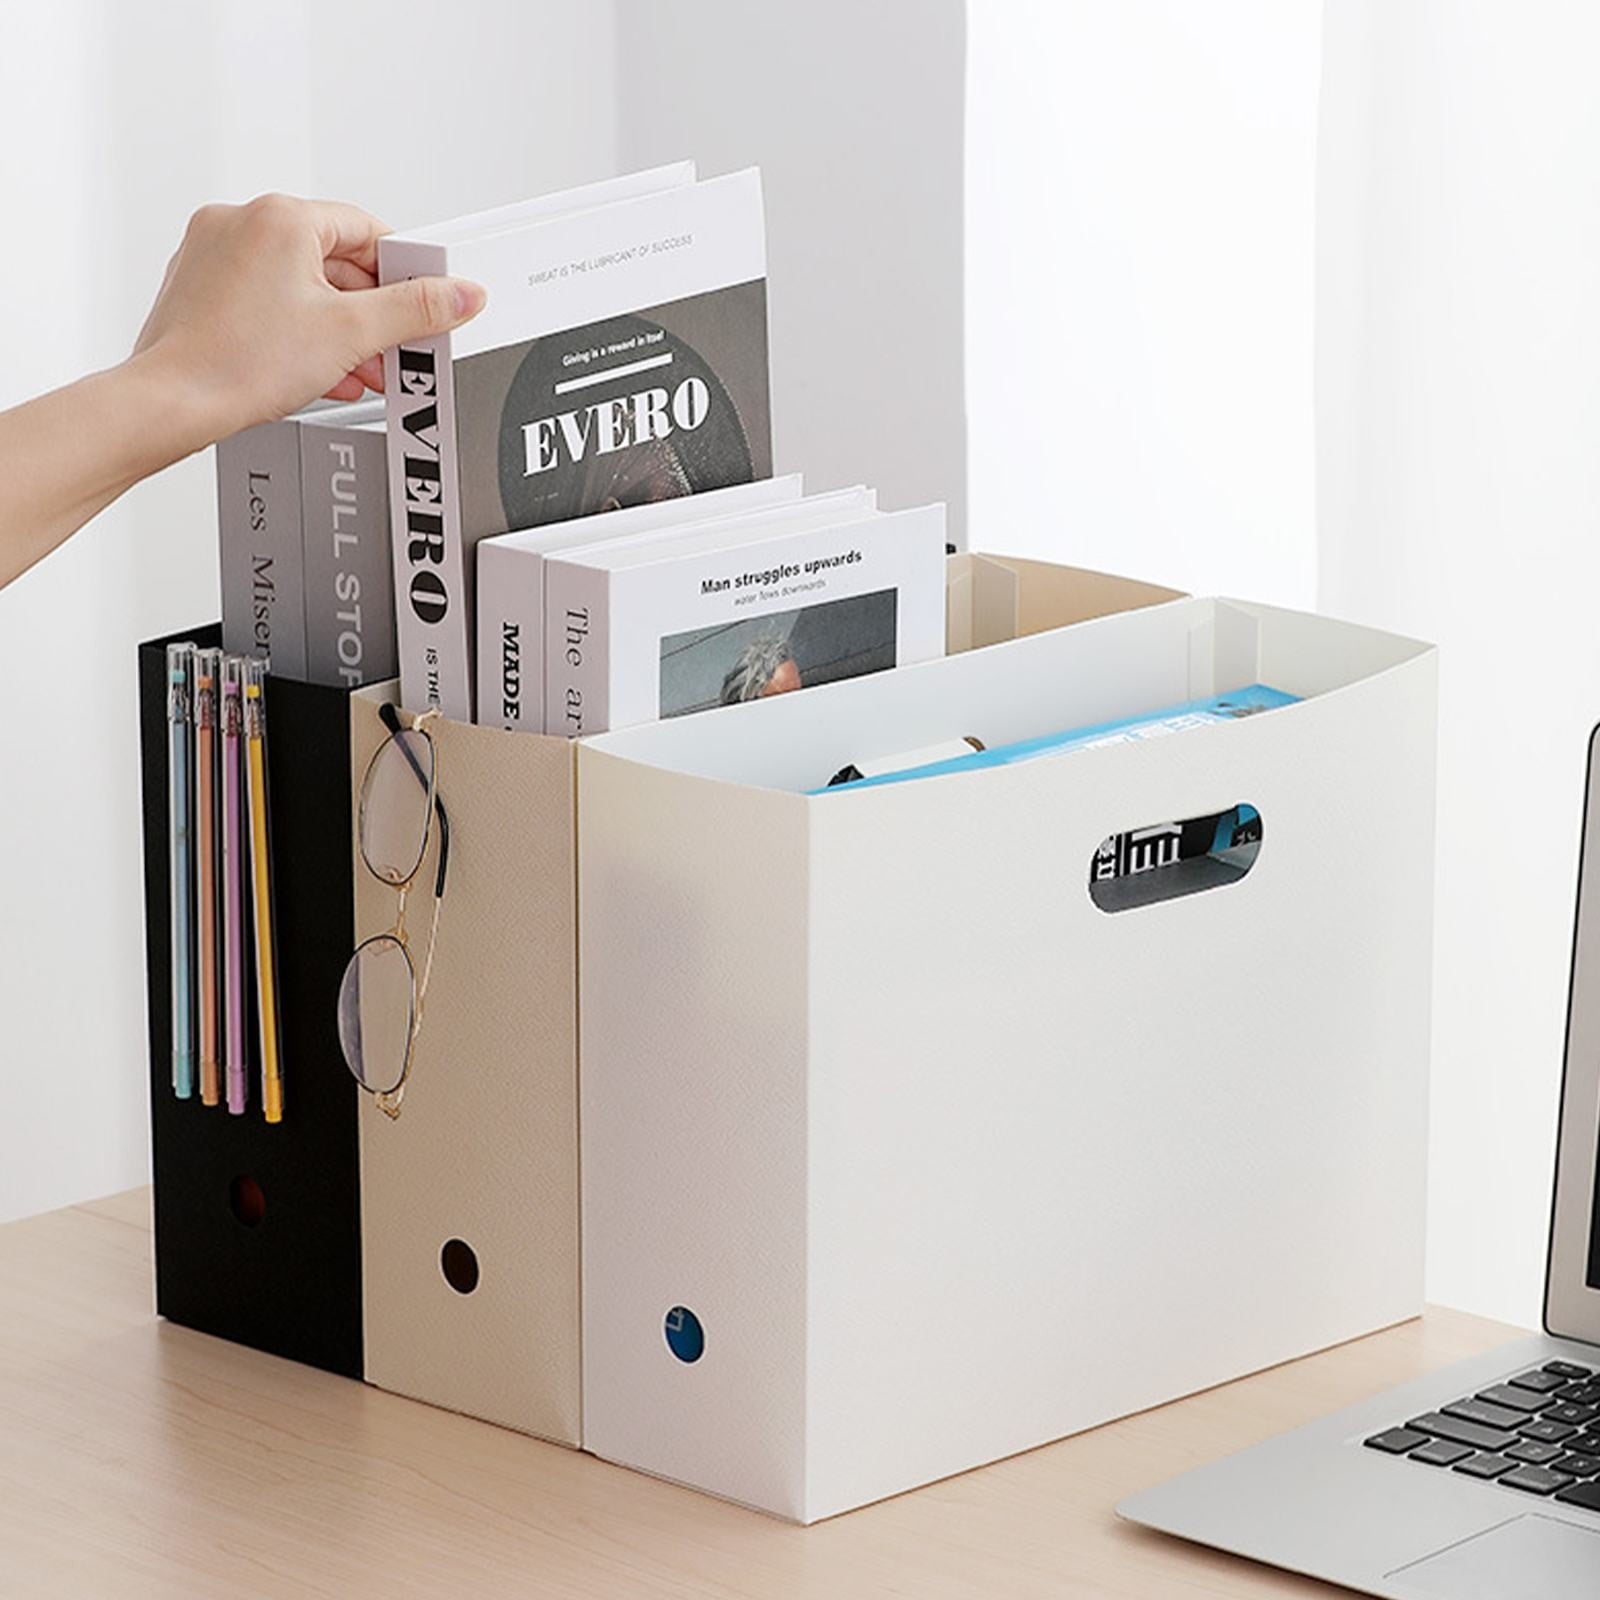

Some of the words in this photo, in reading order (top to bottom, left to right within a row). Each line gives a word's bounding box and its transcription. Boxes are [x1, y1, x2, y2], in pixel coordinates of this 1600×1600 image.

[562, 351, 590, 366] Giving
[521, 377, 710, 477] EVERO
[250, 471, 270, 531] Les
[329, 442, 358, 559] FULL
[399, 345, 448, 624] EVERO
[252, 555, 275, 659] Miser
[700, 577, 731, 594] Man
[734, 563, 800, 588] struggles
[804, 550, 862, 574] upwards
[503, 622, 519, 720] MADE
[565, 607, 589, 667] The
[565, 688, 583, 739] ar
